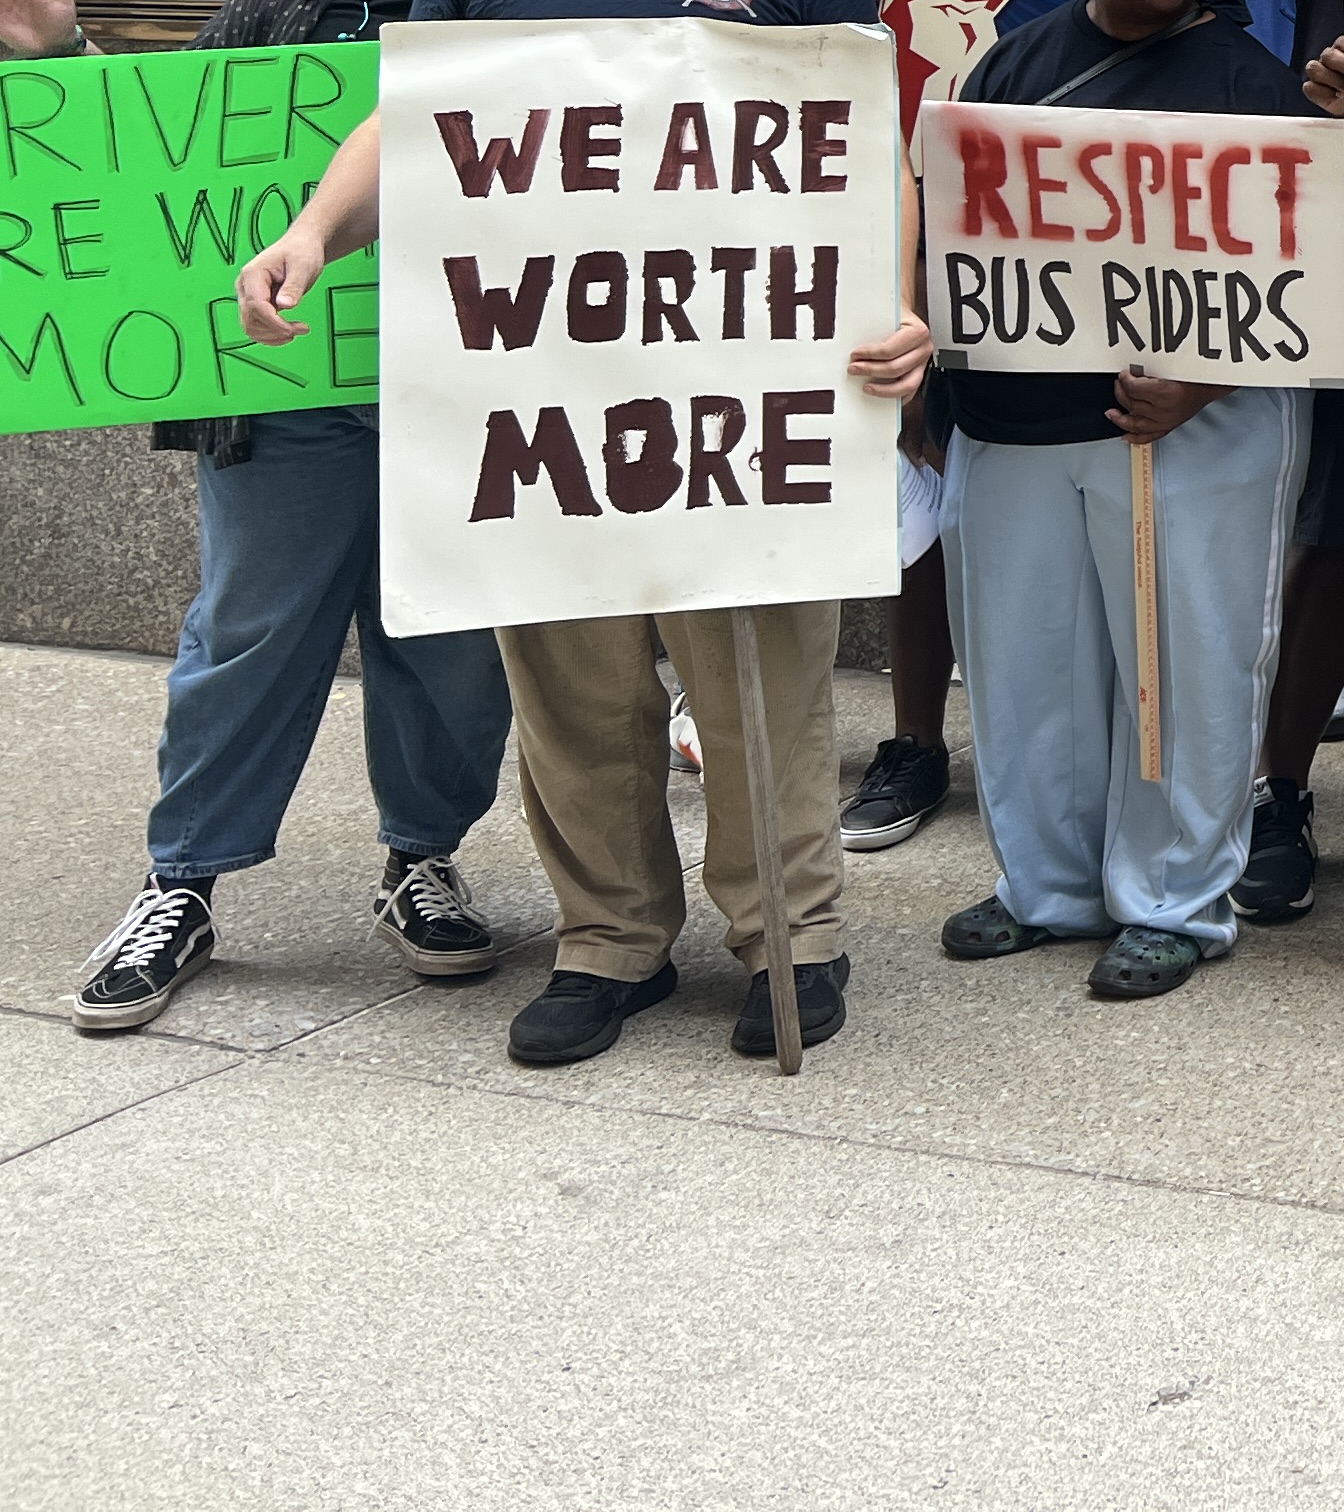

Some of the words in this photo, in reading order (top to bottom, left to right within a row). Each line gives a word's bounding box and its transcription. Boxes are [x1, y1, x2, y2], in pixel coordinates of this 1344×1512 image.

[433, 102, 623, 198] WE
[654, 100, 852, 194] ARE
[957, 129, 1311, 260] RESPECT
[442, 246, 840, 351] WORTH
[945, 252, 1076, 346] BUS
[1101, 261, 1310, 363] RIDERS
[467, 389, 836, 522] MORE
